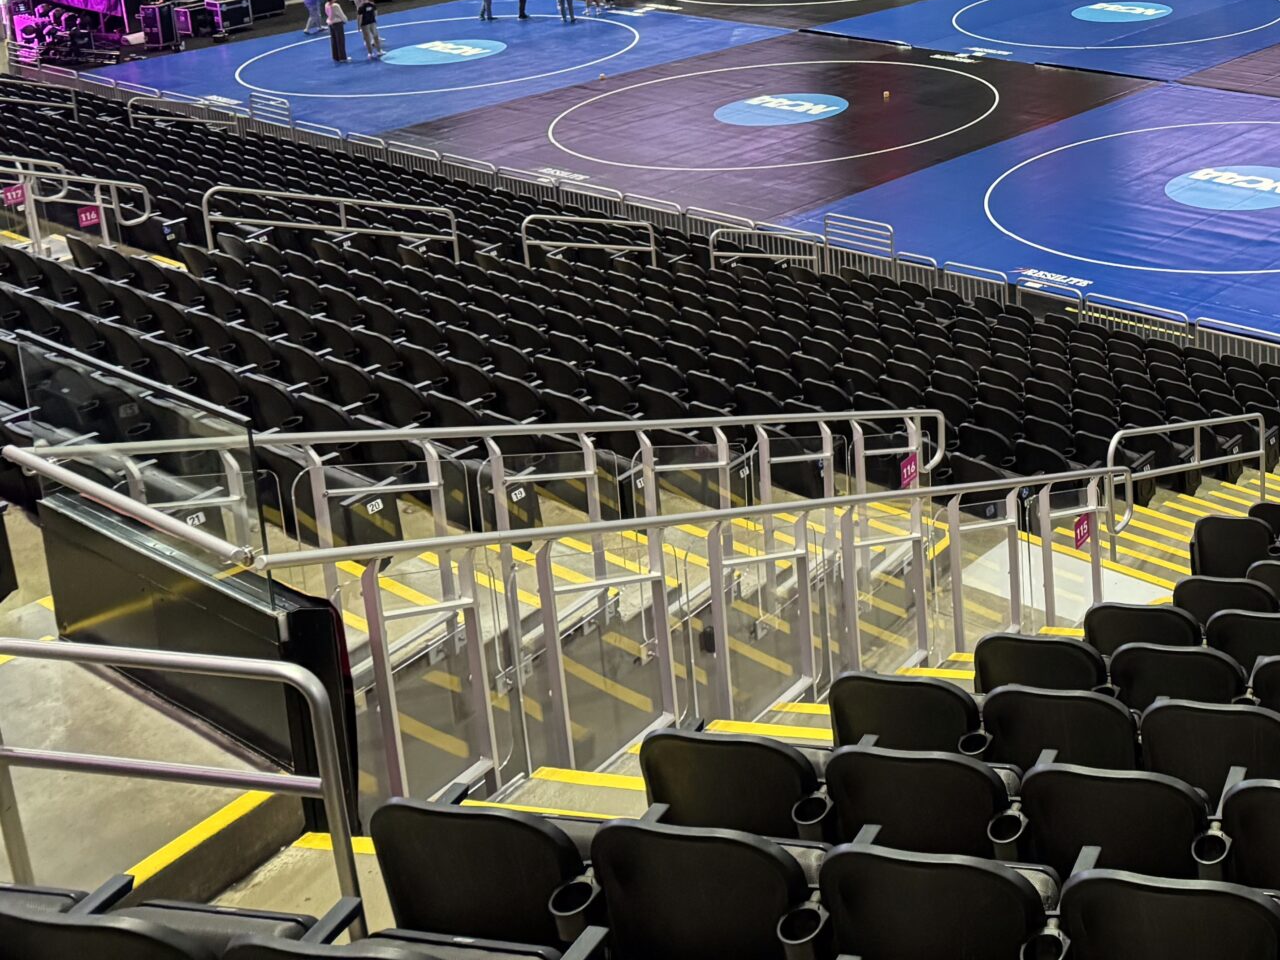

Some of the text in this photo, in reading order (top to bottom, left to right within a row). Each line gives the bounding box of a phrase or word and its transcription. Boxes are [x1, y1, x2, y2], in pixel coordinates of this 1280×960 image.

[744, 95, 840, 115] NCAA
[6, 189, 22, 200] 117
[80, 210, 97, 222] 116
[1021, 268, 1094, 287] RESILITE
[903, 461, 916, 479] 116
[368, 502, 381, 514] 20
[188, 513, 201, 526] 21
[1076, 520, 1089, 540] 115
